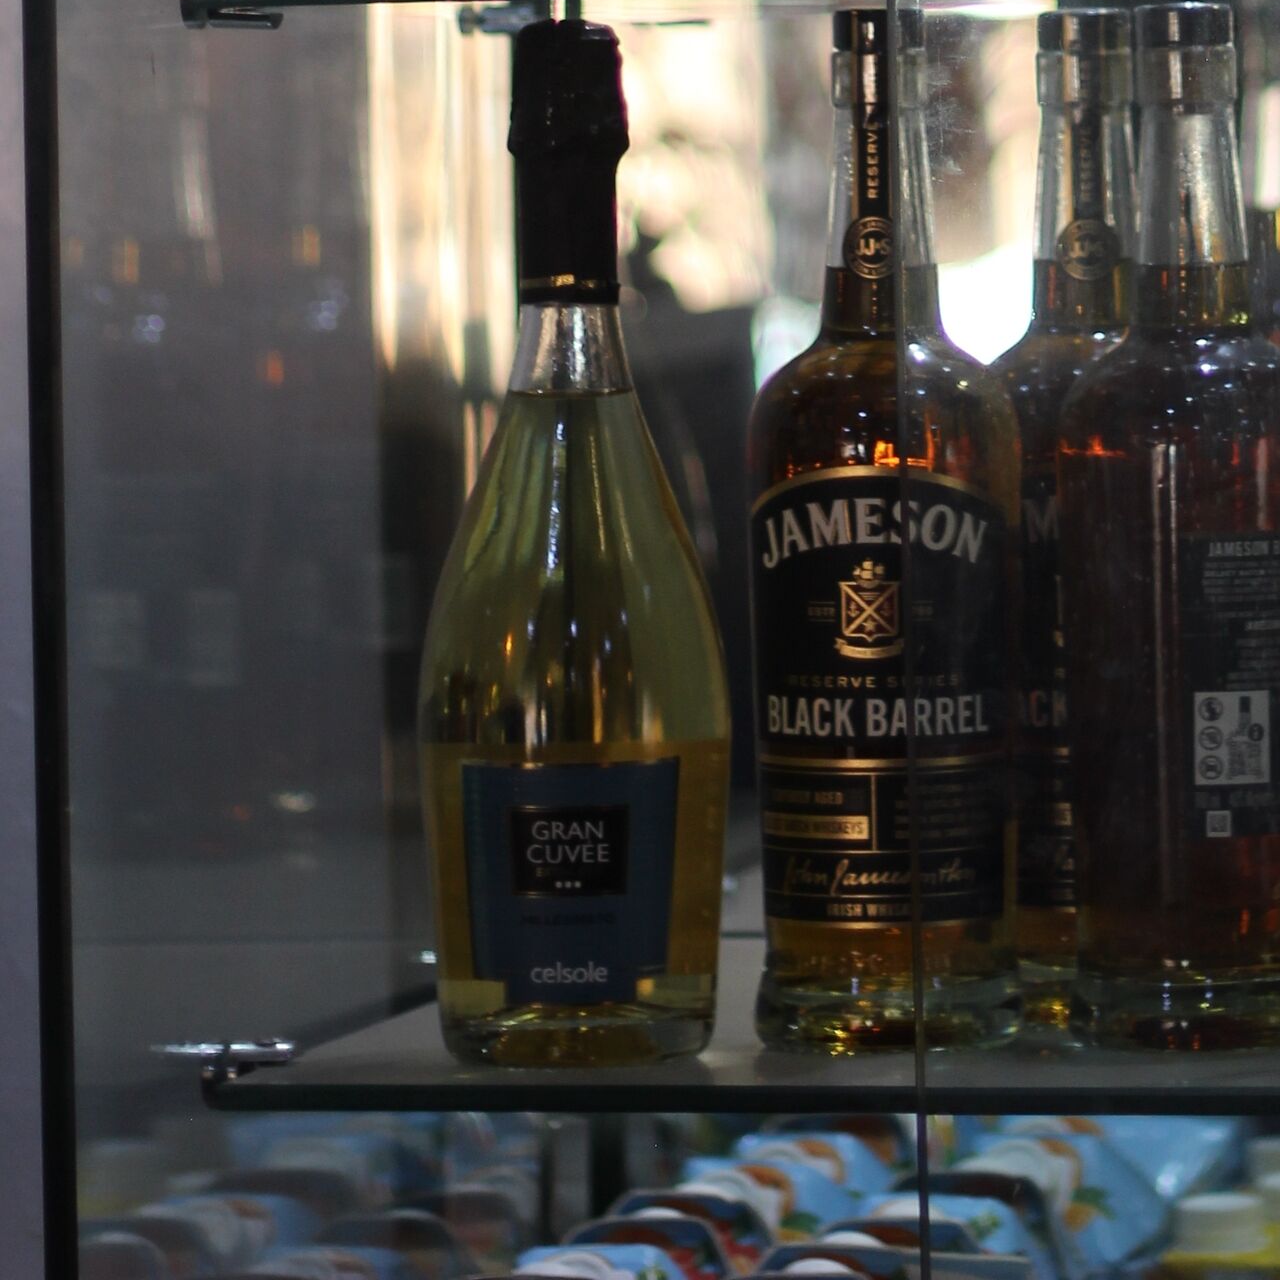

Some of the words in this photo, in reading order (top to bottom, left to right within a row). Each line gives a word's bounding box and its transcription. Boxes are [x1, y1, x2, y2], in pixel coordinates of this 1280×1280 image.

[762, 497, 988, 569] JAMESON
[788, 676, 876, 689] RESERVE
[886, 674, 961, 689] SRIES
[767, 695, 855, 737] BLACK
[866, 693, 989, 737] BARREL
[531, 820, 604, 840] GRAN
[530, 961, 608, 984] celsole
